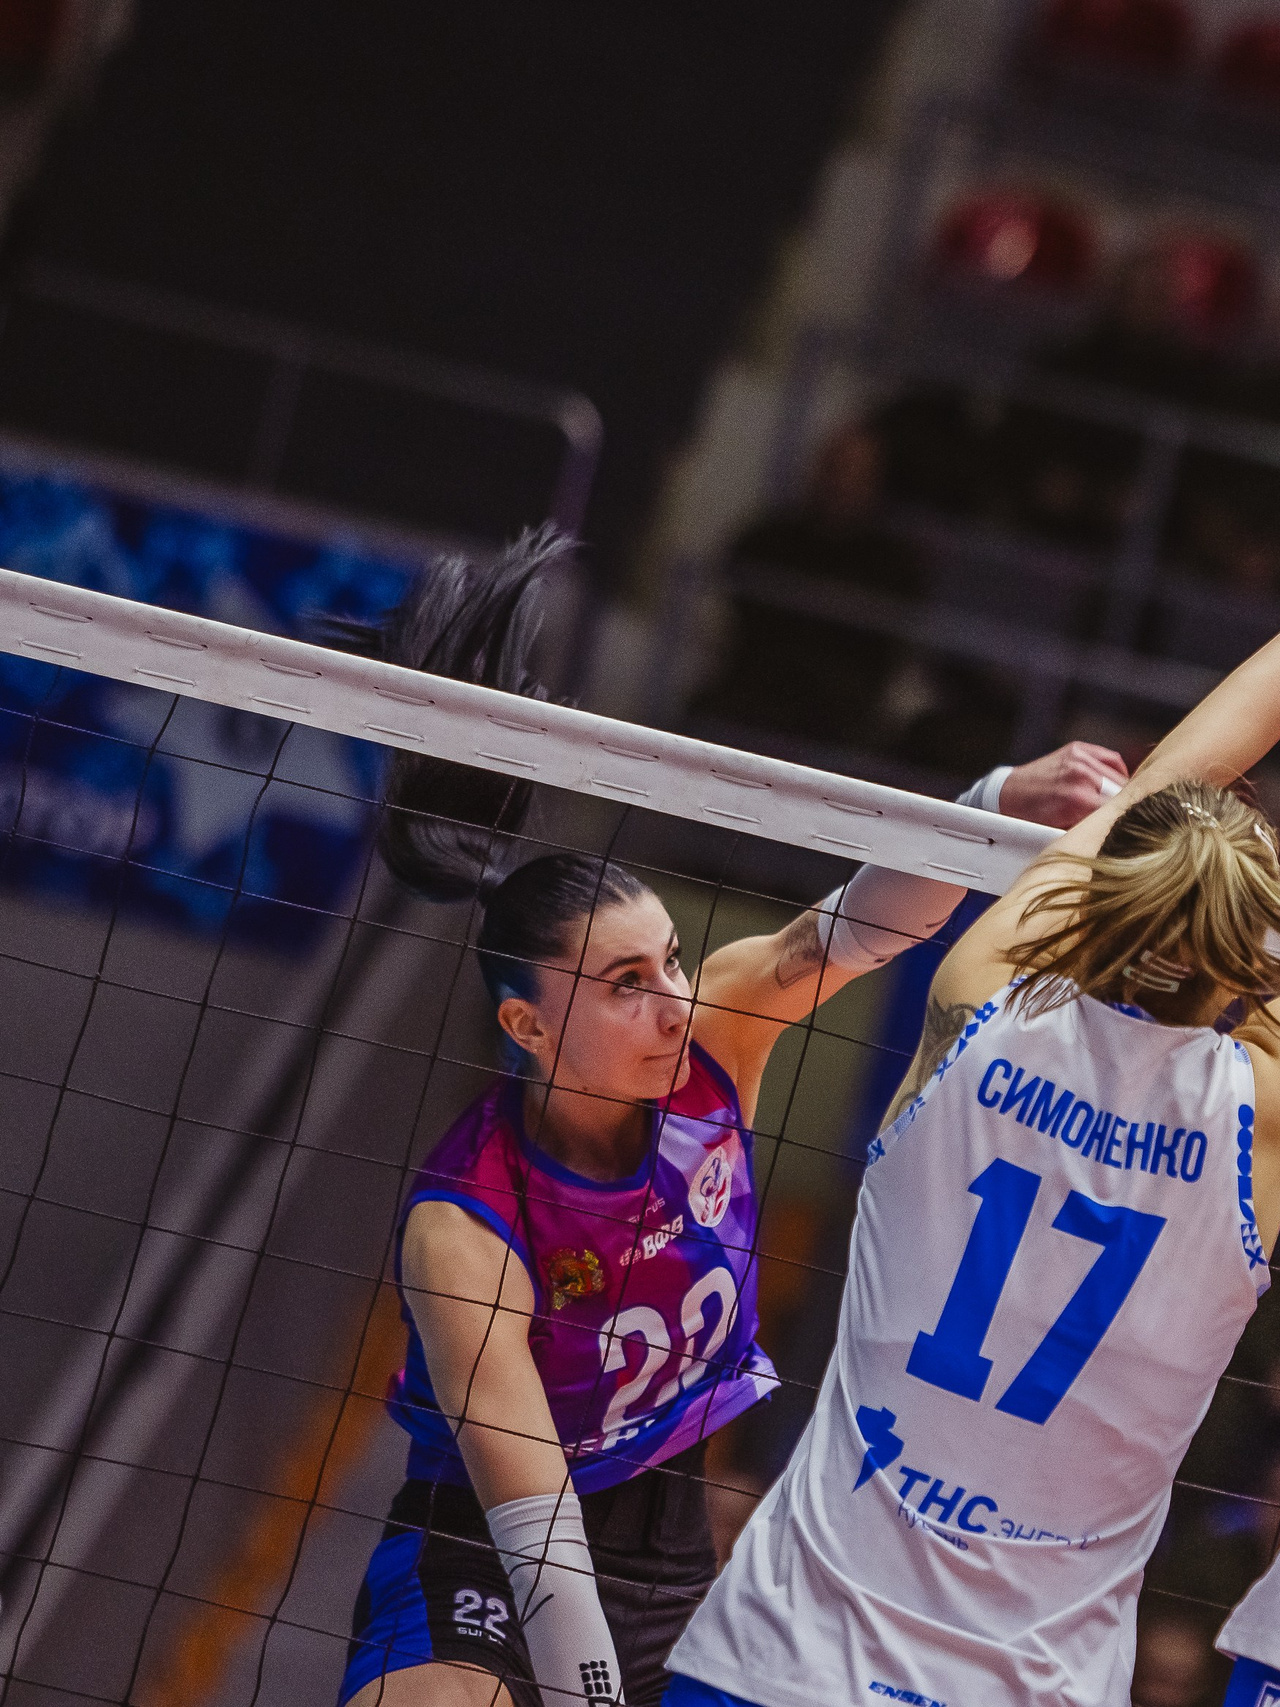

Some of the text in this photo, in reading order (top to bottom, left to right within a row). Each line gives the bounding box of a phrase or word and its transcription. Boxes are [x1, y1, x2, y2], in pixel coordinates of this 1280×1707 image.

[977, 1059, 1208, 1184] СИМОНЕНКО
[598, 1266, 739, 1434] 22
[906, 1157, 1168, 1426] 17
[899, 1465, 999, 1534] ТНС
[454, 1589, 509, 1639] 22
